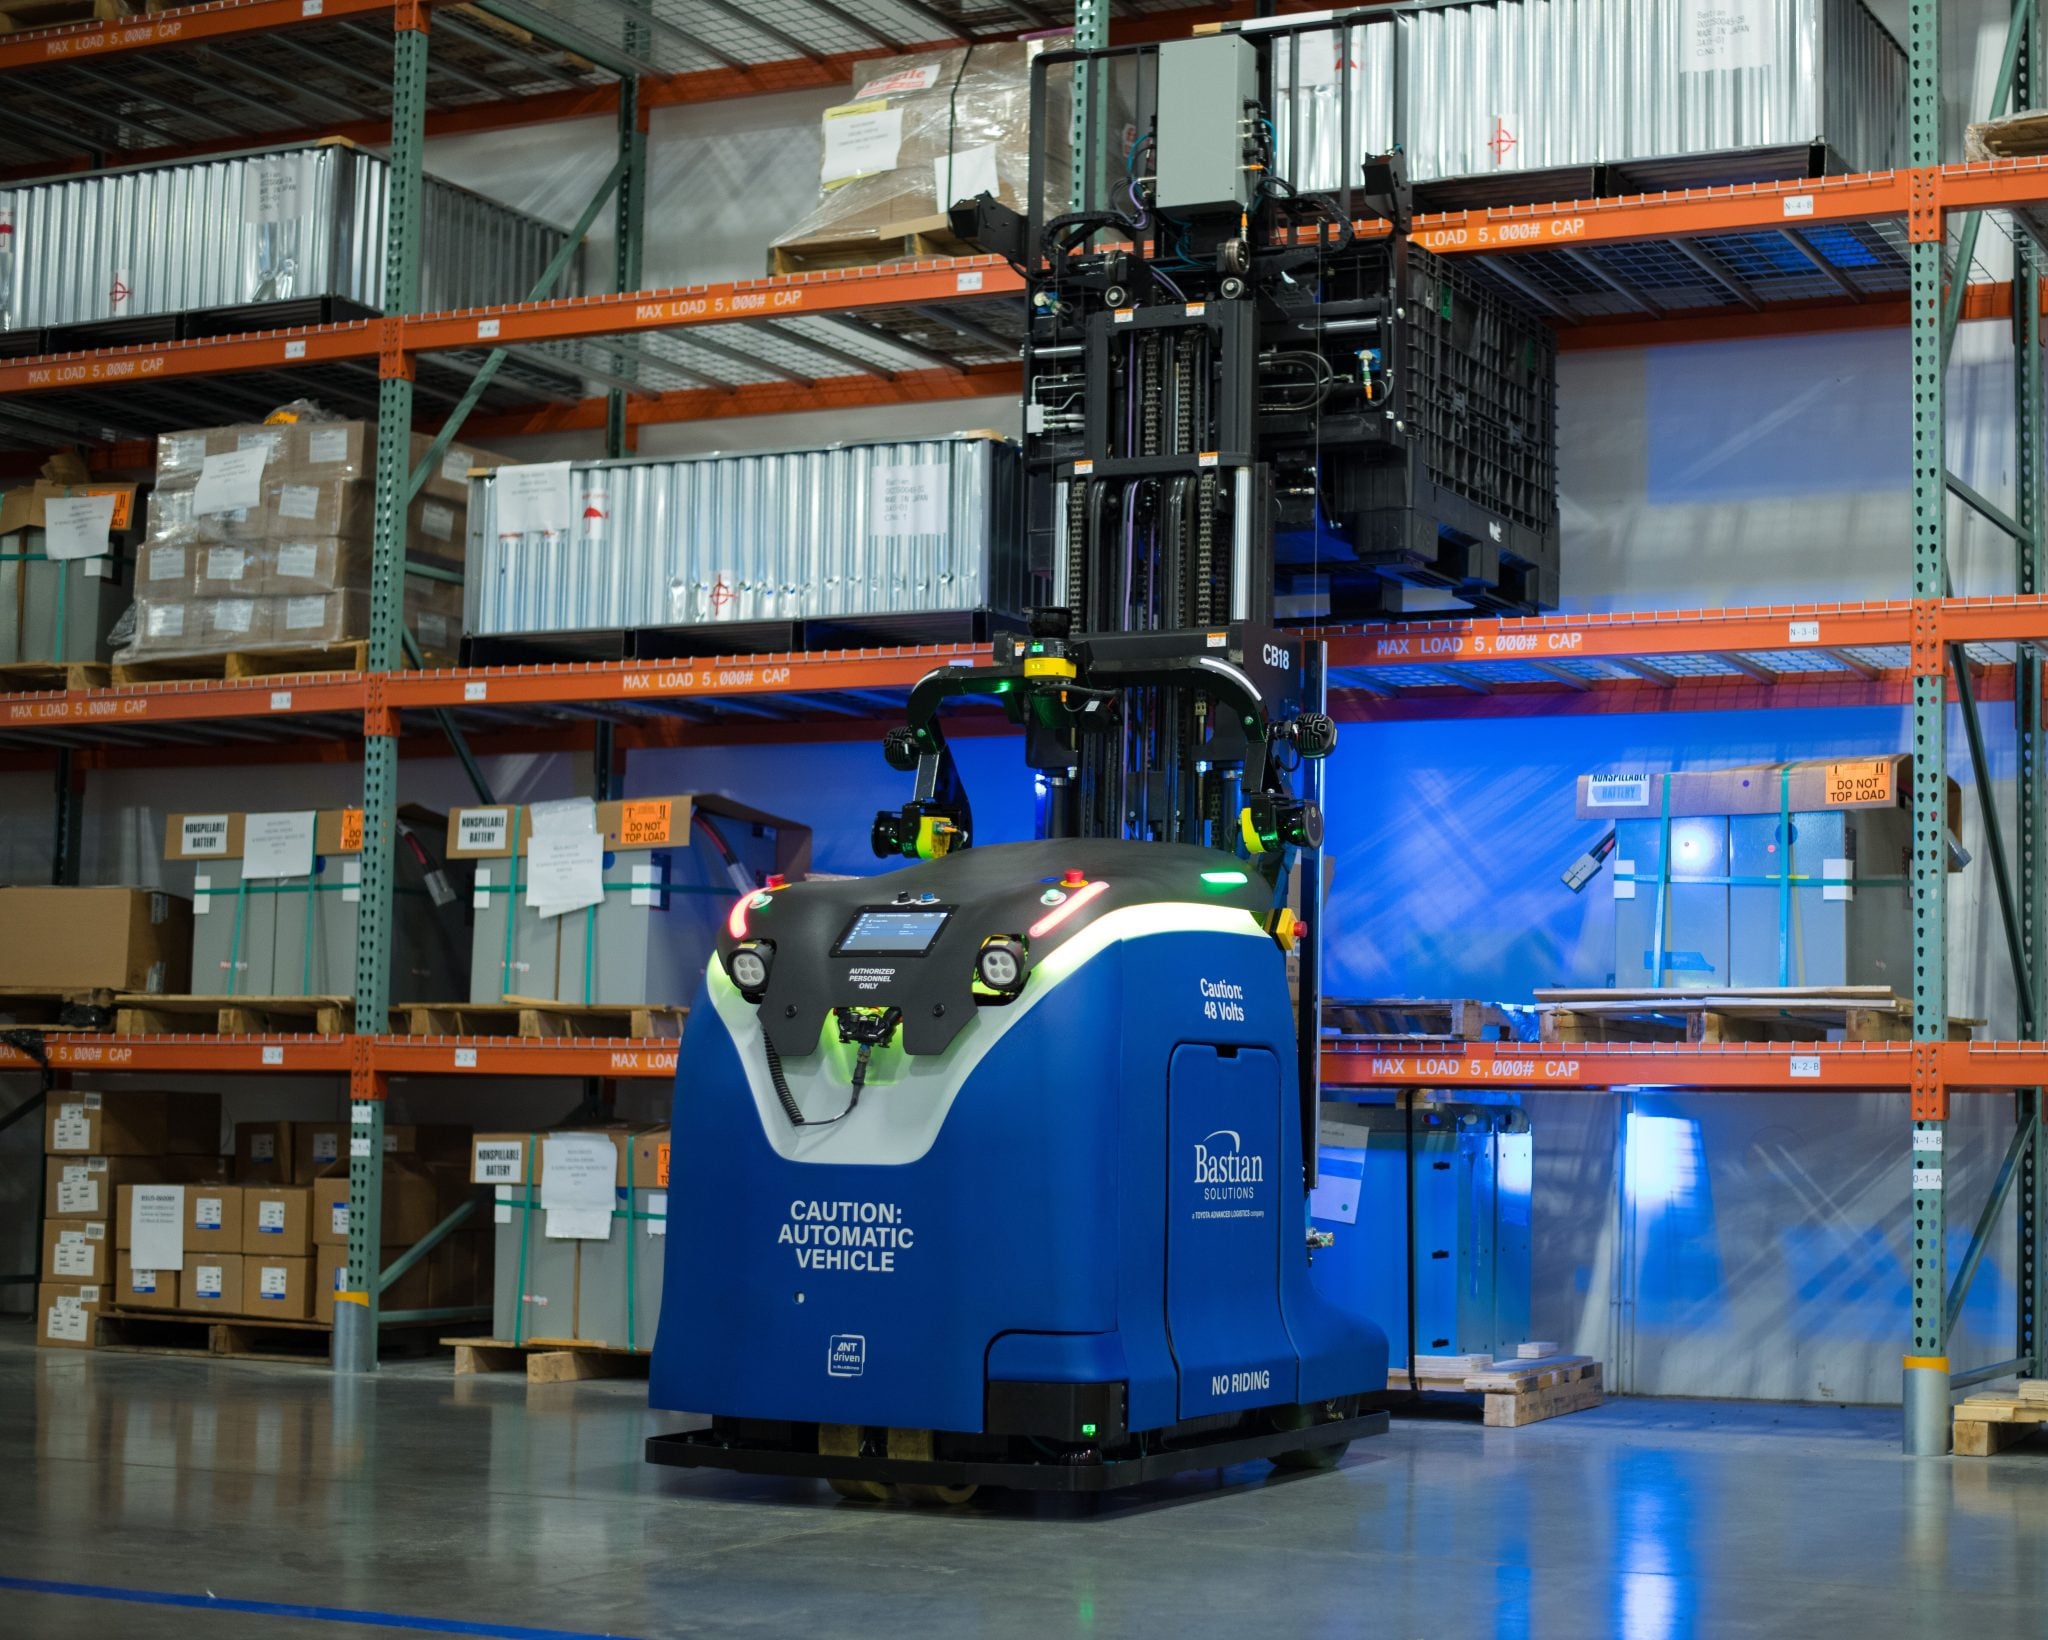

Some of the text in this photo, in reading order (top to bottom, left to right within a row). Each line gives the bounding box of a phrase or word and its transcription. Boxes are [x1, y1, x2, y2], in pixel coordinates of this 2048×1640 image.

[47, 41, 69, 56] MAX
[75, 35, 104, 51] LOAD
[159, 23, 182, 38] CAP
[1425, 229, 1467, 247] LOAD
[1478, 223, 1540, 244] 5,000#
[1551, 218, 1584, 236] CAP
[636, 304, 663, 320] MAX
[671, 299, 706, 317] LOAD
[774, 289, 802, 306] CAP
[28, 370, 51, 384] MAX
[57, 365, 86, 382] LOAD
[140, 357, 164, 373] CAP
[1790, 625, 1818, 636] N-3-B
[1377, 632, 1582, 655] MAX LOAD 5,000# CAP
[1263, 643, 1290, 670] CB18
[623, 673, 650, 690] MAX
[658, 671, 693, 688] LOAD
[762, 668, 790, 684] CAP
[11, 704, 33, 718] MAX
[40, 702, 69, 718] LOAD
[124, 699, 148, 714] CAP
[1837, 778, 1879, 790] DO NOT
[1830, 789, 1886, 802] TOP LOAD
[185, 822, 226, 834] NONSPILLABLE
[461, 815, 505, 828] NONSPILLABLE
[630, 821, 662, 832] DO NOT
[192, 837, 217, 849] BATTERY
[344, 839, 360, 849] TOP
[469, 832, 496, 843] BATTERY
[624, 831, 666, 843] TOP LOAD
[1200, 978, 1243, 1000] Caution:
[1204, 1001, 1245, 1022] 48 Volts
[109, 1048, 133, 1062] CAP
[611, 1053, 638, 1068] MAX
[1372, 1058, 1580, 1078] MAX LOAD 5,000# CAP
[1791, 1062, 1819, 1072] N-2-B
[1913, 1136, 1942, 1145] N-1-B
[478, 1149, 519, 1161] NONSPILLABLE
[486, 1165, 511, 1176] BATTERY
[1194, 1144, 1264, 1183] Bastian
[1204, 1186, 1254, 1200] SOLUTIONS
[790, 1200, 902, 1224] CAUTION:
[1195, 1211, 1211, 1219] TOYOTA
[1210, 1210, 1230, 1218] ADVANCED
[1231, 1209, 1250, 1217] LOGISTICS
[778, 1224, 914, 1249] AUTOMATIC
[796, 1248, 895, 1272] VEHICLE
[837, 1342, 858, 1352] ANT
[833, 1352, 860, 1363] driven
[1212, 1370, 1270, 1396] NO RIDING
